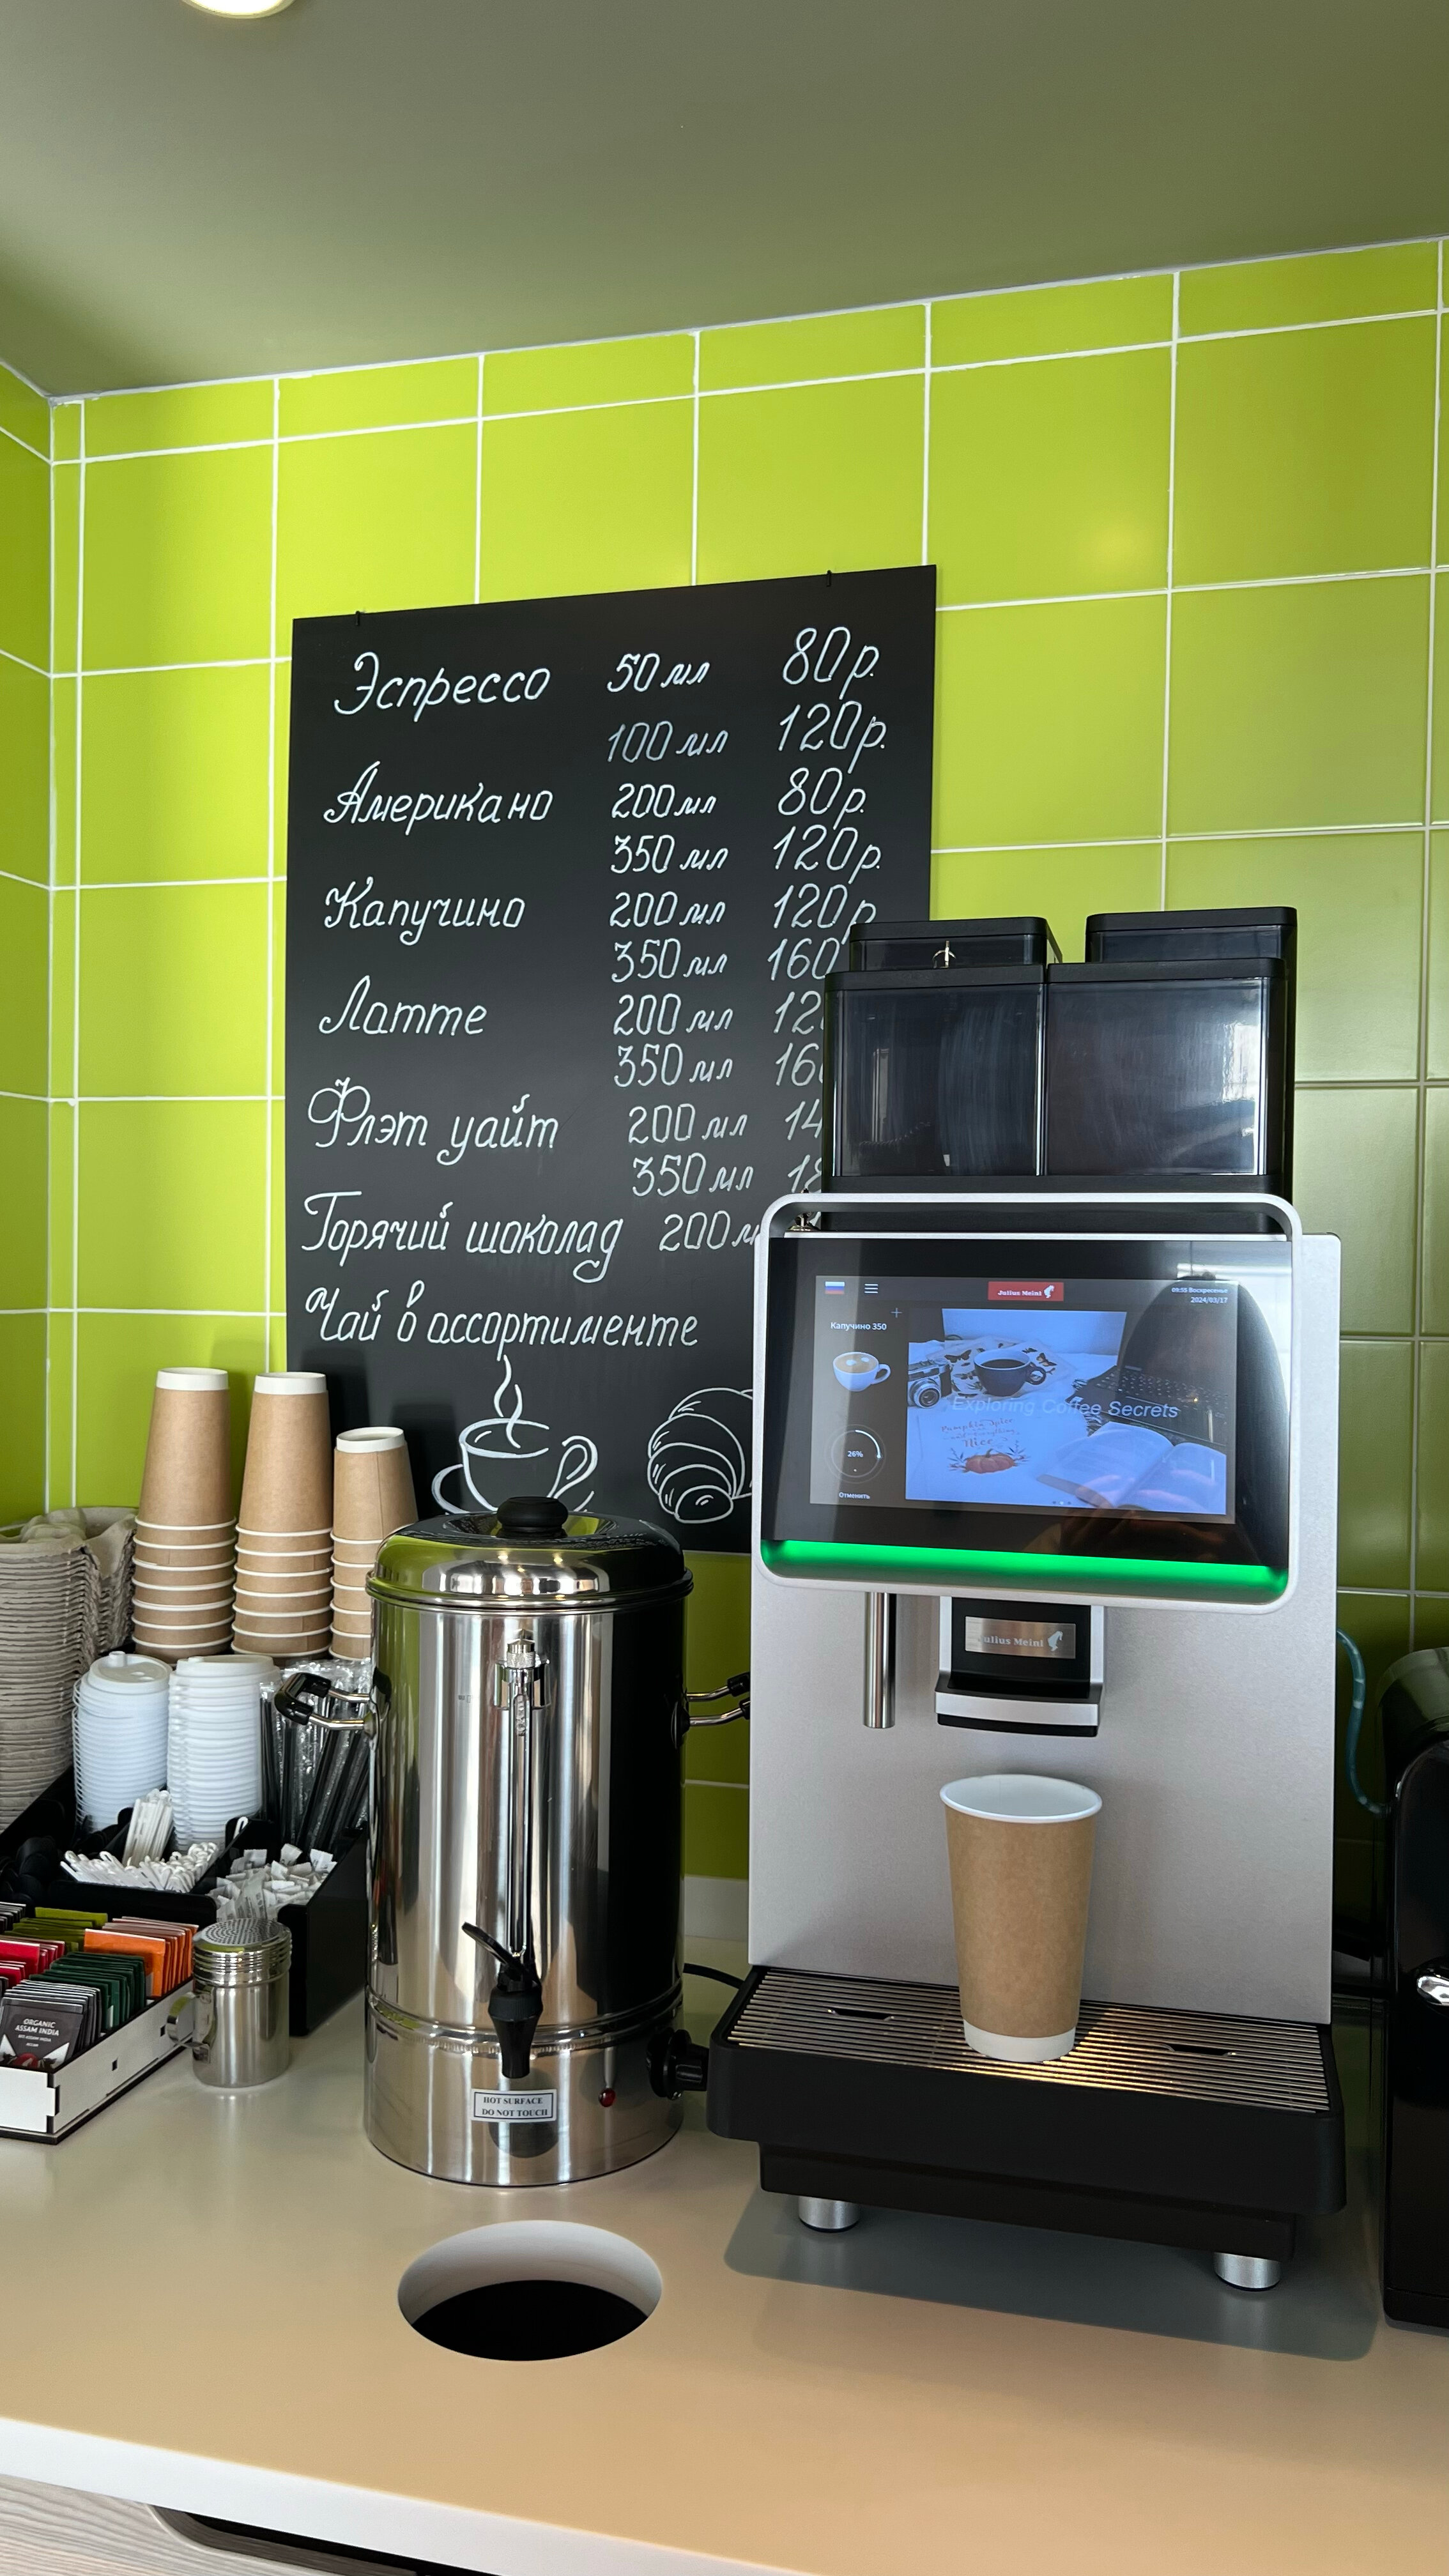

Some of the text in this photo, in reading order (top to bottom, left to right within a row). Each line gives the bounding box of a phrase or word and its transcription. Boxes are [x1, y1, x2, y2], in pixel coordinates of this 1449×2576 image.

[334, 651, 551, 723] Эспрессо
[606, 652, 660, 693] 50
[659, 661, 710, 689] мл
[607, 720, 673, 763] 100
[676, 730, 729, 757] мл
[323, 760, 553, 836] Американо
[610, 834, 675, 874] 350
[679, 847, 729, 871] мл
[324, 876, 526, 946] Капучино
[609, 891, 678, 928] 200
[611, 937, 681, 983] 350
[682, 953, 728, 978] мл
[318, 974, 824, 1036] Латте 200 мл 12
[613, 1042, 824, 1087] 350 мл 16
[307, 1077, 428, 1148] Флэт
[436, 1093, 559, 1166] уайт
[628, 1103, 696, 1144] 200
[701, 1114, 748, 1140] мл
[632, 1152, 707, 1197] 350
[708, 1165, 754, 1193] мл
[301, 1190, 759, 1284] Горячий шоколад 200 м
[305, 1280, 698, 1361] Чай в ассортименте
[831, 1322, 887, 1331] Капучино 350
[952, 1397, 1179, 1418] Exploring Coffee Secrets
[1013, 1637, 1044, 1648] Meinl
[15, 2025, 59, 2037] ASSAM INDIA
[23, 2018, 56, 2028] ORGANIC
[482, 2108, 494, 2117] DO
[516, 2109, 548, 2117] TOUCH
[484, 2096, 543, 2105] HOT SURFACE
